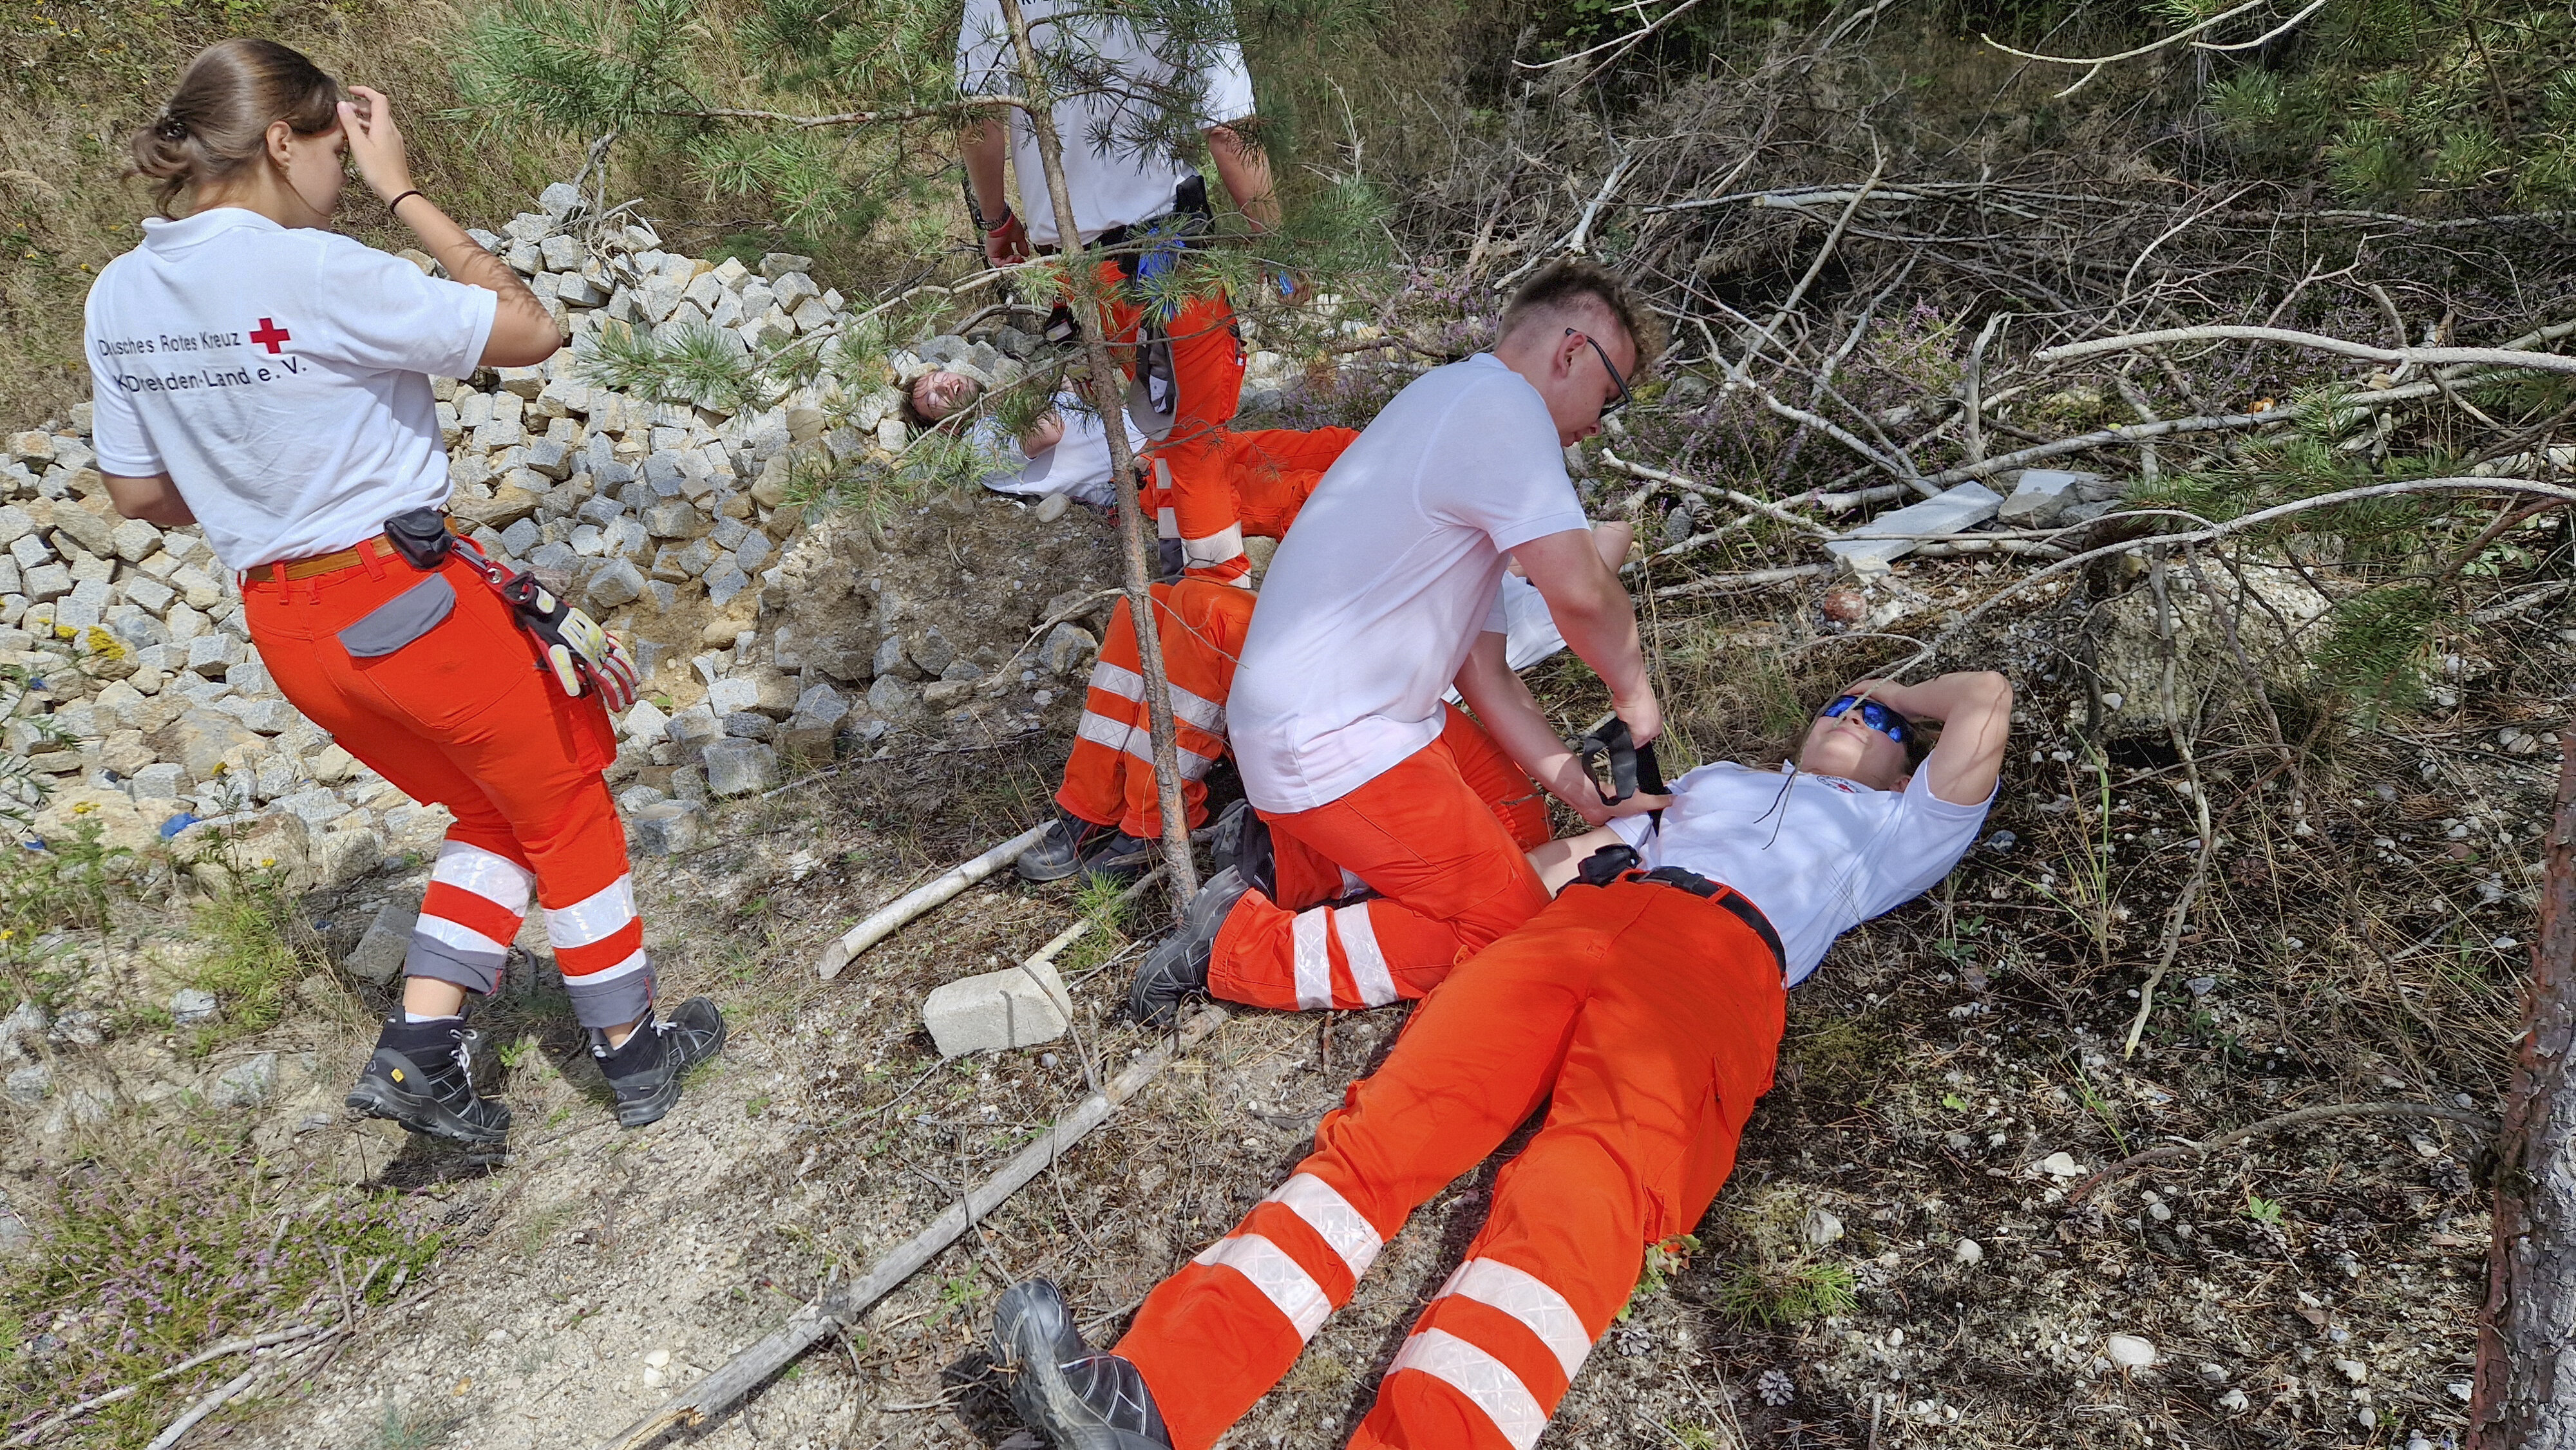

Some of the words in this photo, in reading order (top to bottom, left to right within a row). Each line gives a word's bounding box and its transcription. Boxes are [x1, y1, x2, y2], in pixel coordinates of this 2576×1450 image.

[160, 334, 197, 352] Rotes
[199, 331, 242, 350] Kreuz
[257, 367, 281, 382] e.
[280, 356, 307, 375] V.
